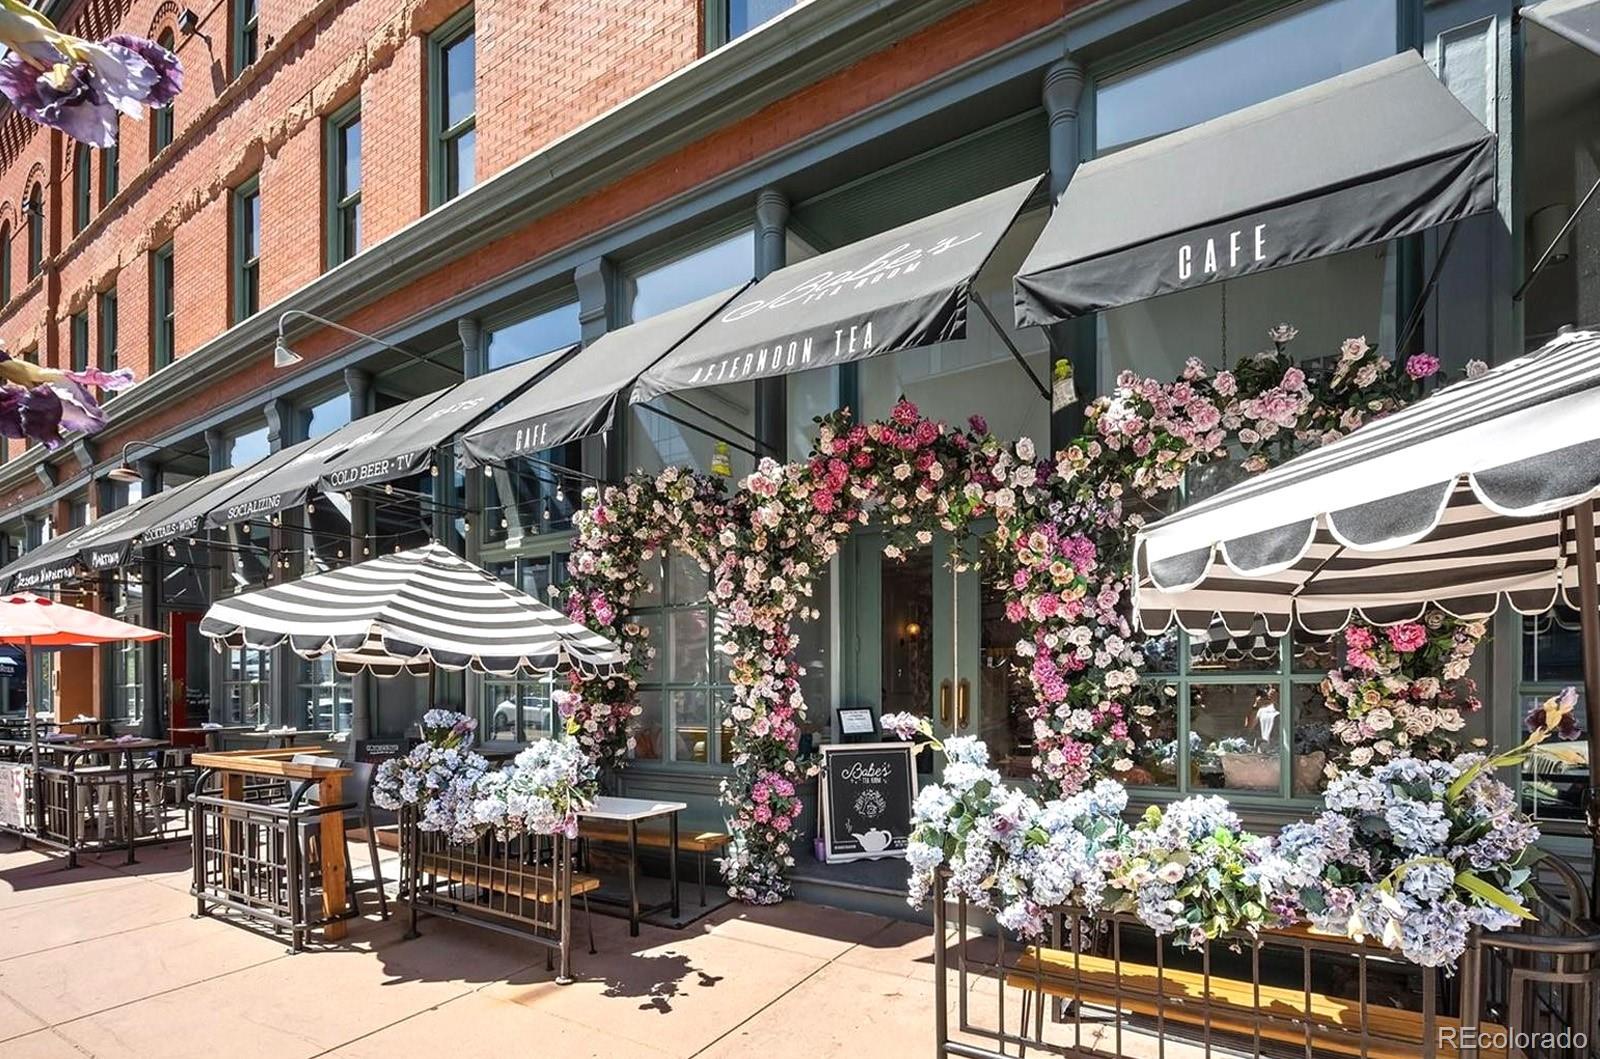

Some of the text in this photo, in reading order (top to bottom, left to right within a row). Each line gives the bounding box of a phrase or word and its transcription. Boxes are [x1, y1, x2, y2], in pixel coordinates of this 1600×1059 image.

[1178, 223, 1266, 280] CAFE
[688, 321, 874, 383] AFTERNOON TEA
[514, 422, 548, 451] CAFE
[331, 453, 416, 487] COLD BEER TV
[227, 495, 281, 519] SOCIALIZING
